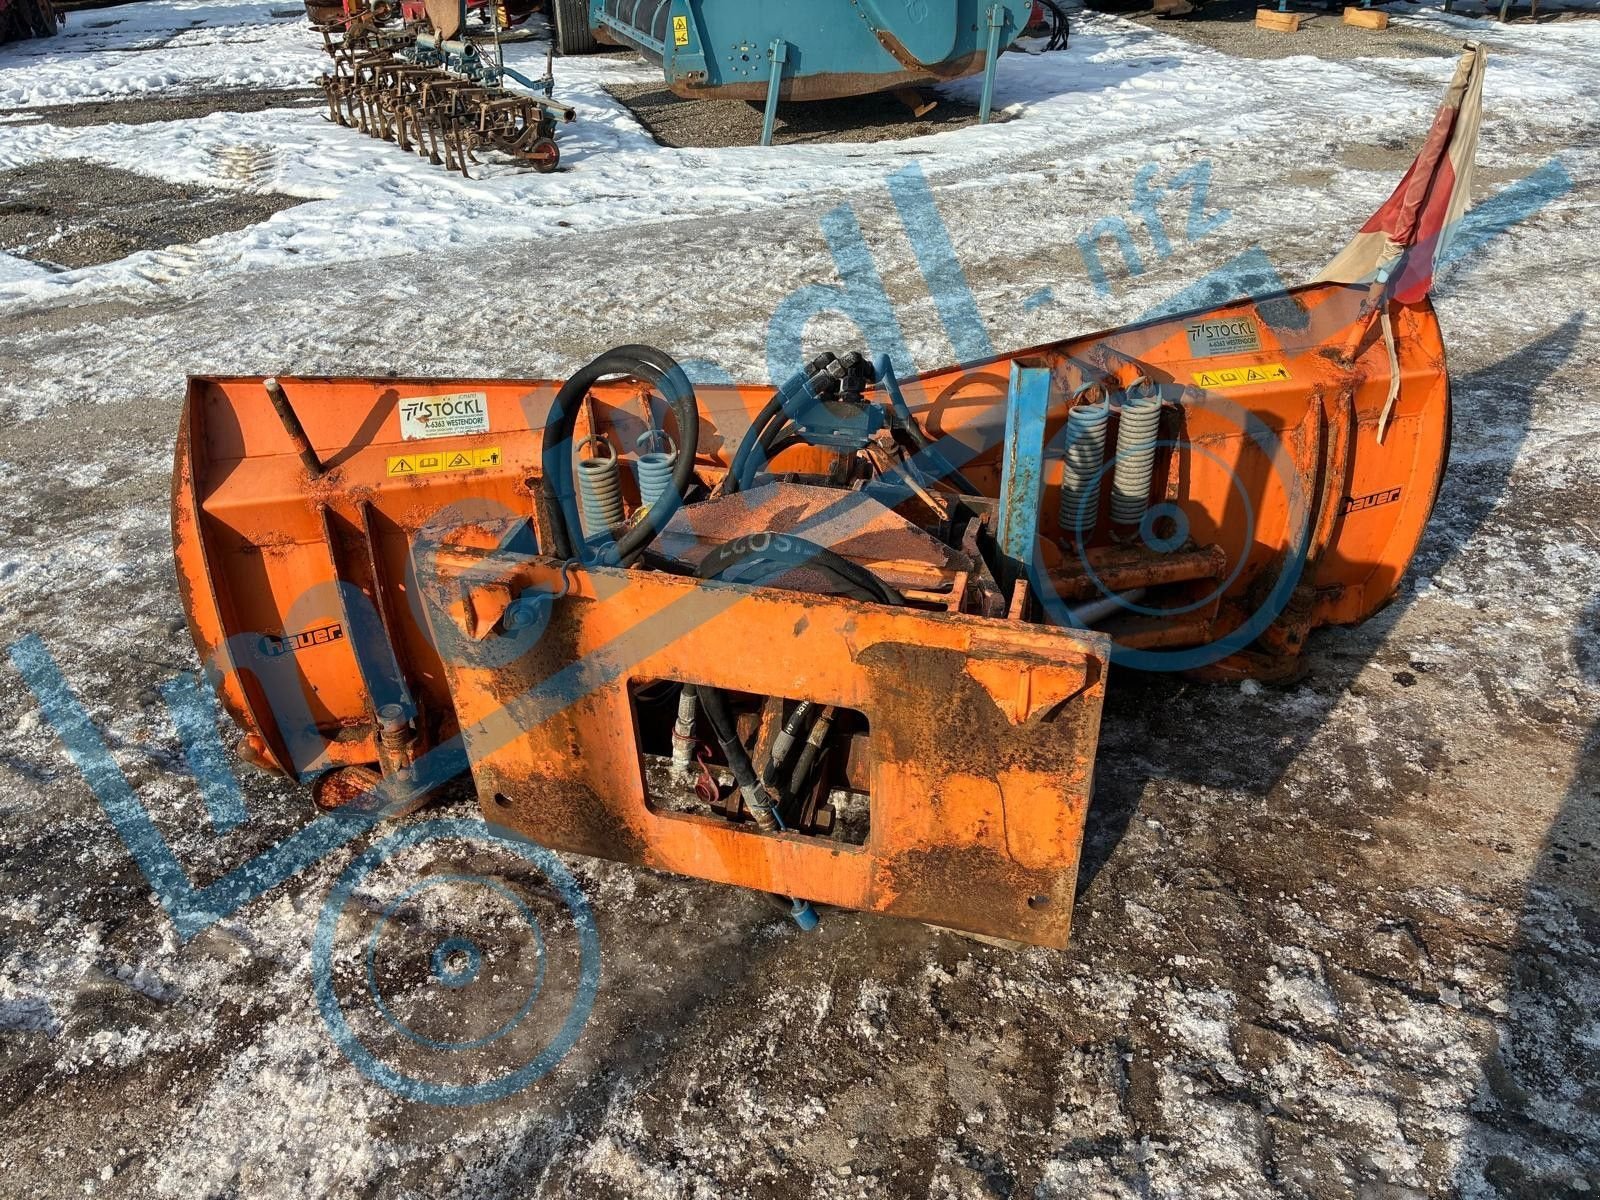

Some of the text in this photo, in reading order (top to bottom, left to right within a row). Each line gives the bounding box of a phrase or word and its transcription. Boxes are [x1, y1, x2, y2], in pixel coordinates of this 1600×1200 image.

[424, 397, 483, 417] STÖCKL
[425, 420, 446, 429] A-6363
[446, 417, 484, 427] WESTENDORF
